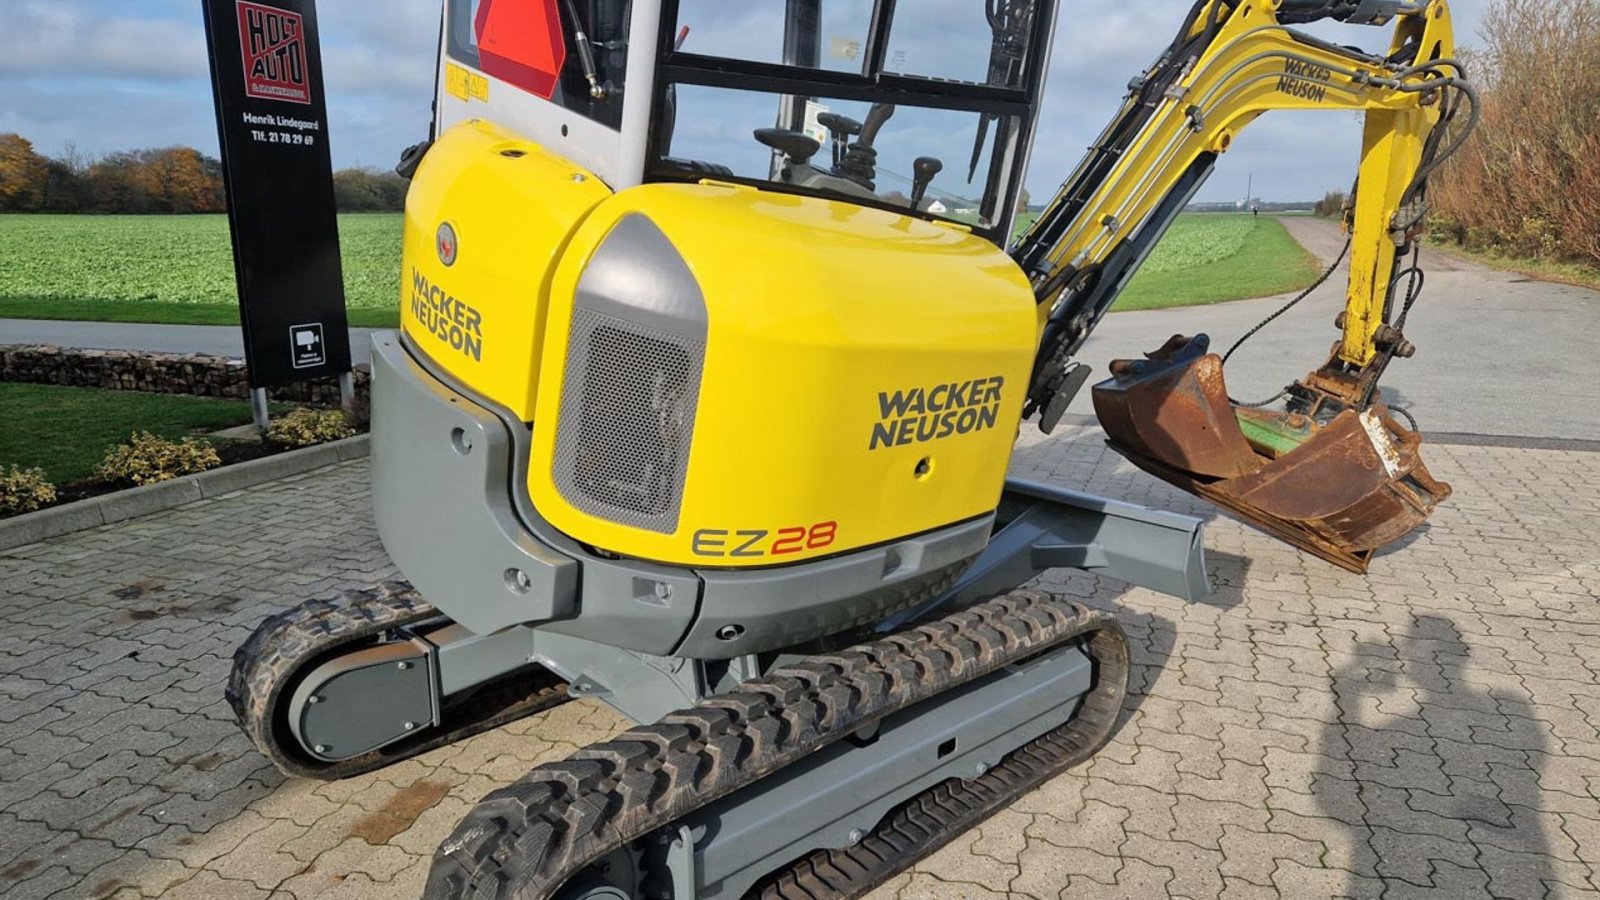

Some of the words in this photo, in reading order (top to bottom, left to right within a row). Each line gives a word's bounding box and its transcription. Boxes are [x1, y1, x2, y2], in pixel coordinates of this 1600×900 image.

[246, 8, 298, 56] HOLT
[250, 39, 305, 85] AUTO
[1284, 57, 1331, 82] WACKER
[1276, 75, 1326, 103] NEUSON
[243, 112, 276, 125] Henrik
[276, 115, 319, 130] Lindegaard
[251, 130, 267, 142] Tlf.
[268, 131, 279, 142] 21
[280, 132, 291, 144] 78
[292, 134, 303, 145] 29
[304, 135, 314, 145] 69
[412, 266, 483, 337] WACKER
[411, 292, 483, 363] NEUSON
[878, 376, 1004, 420] WACKER
[869, 403, 999, 450] NEUSON
[692, 521, 838, 557] EZ28
